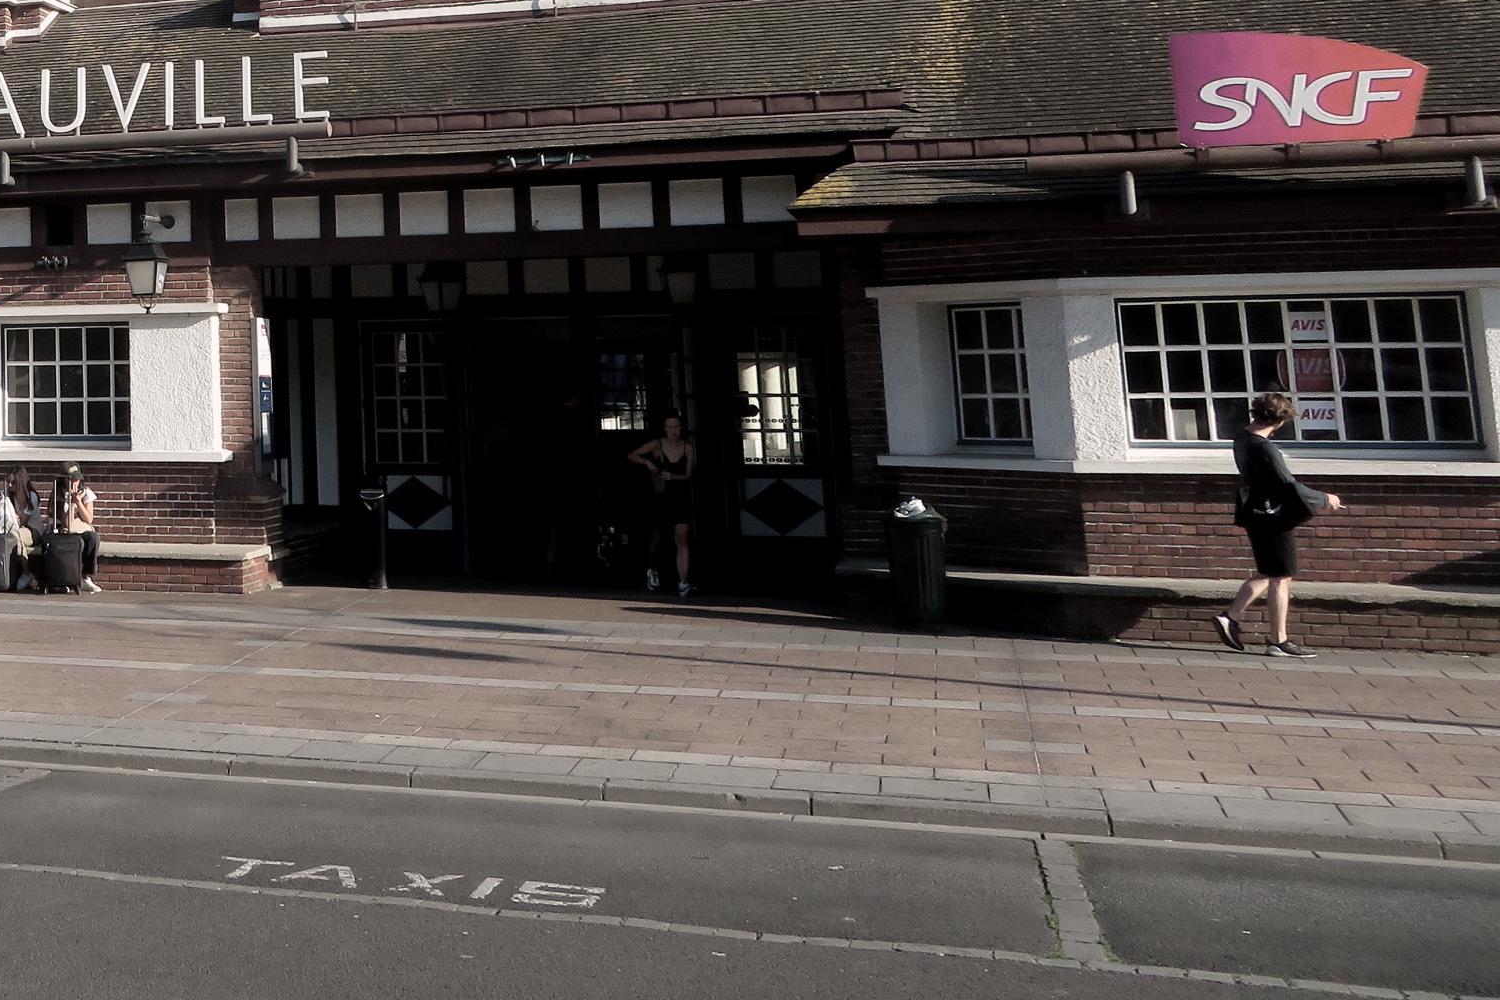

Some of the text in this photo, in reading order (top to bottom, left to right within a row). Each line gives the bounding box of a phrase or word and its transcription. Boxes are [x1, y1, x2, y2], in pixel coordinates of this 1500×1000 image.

[1193, 68, 1413, 132] SNCF
[1291, 319, 1326, 331] AVIS
[1301, 408, 1337, 420] AVIS
[220, 855, 607, 909] TAXIS
